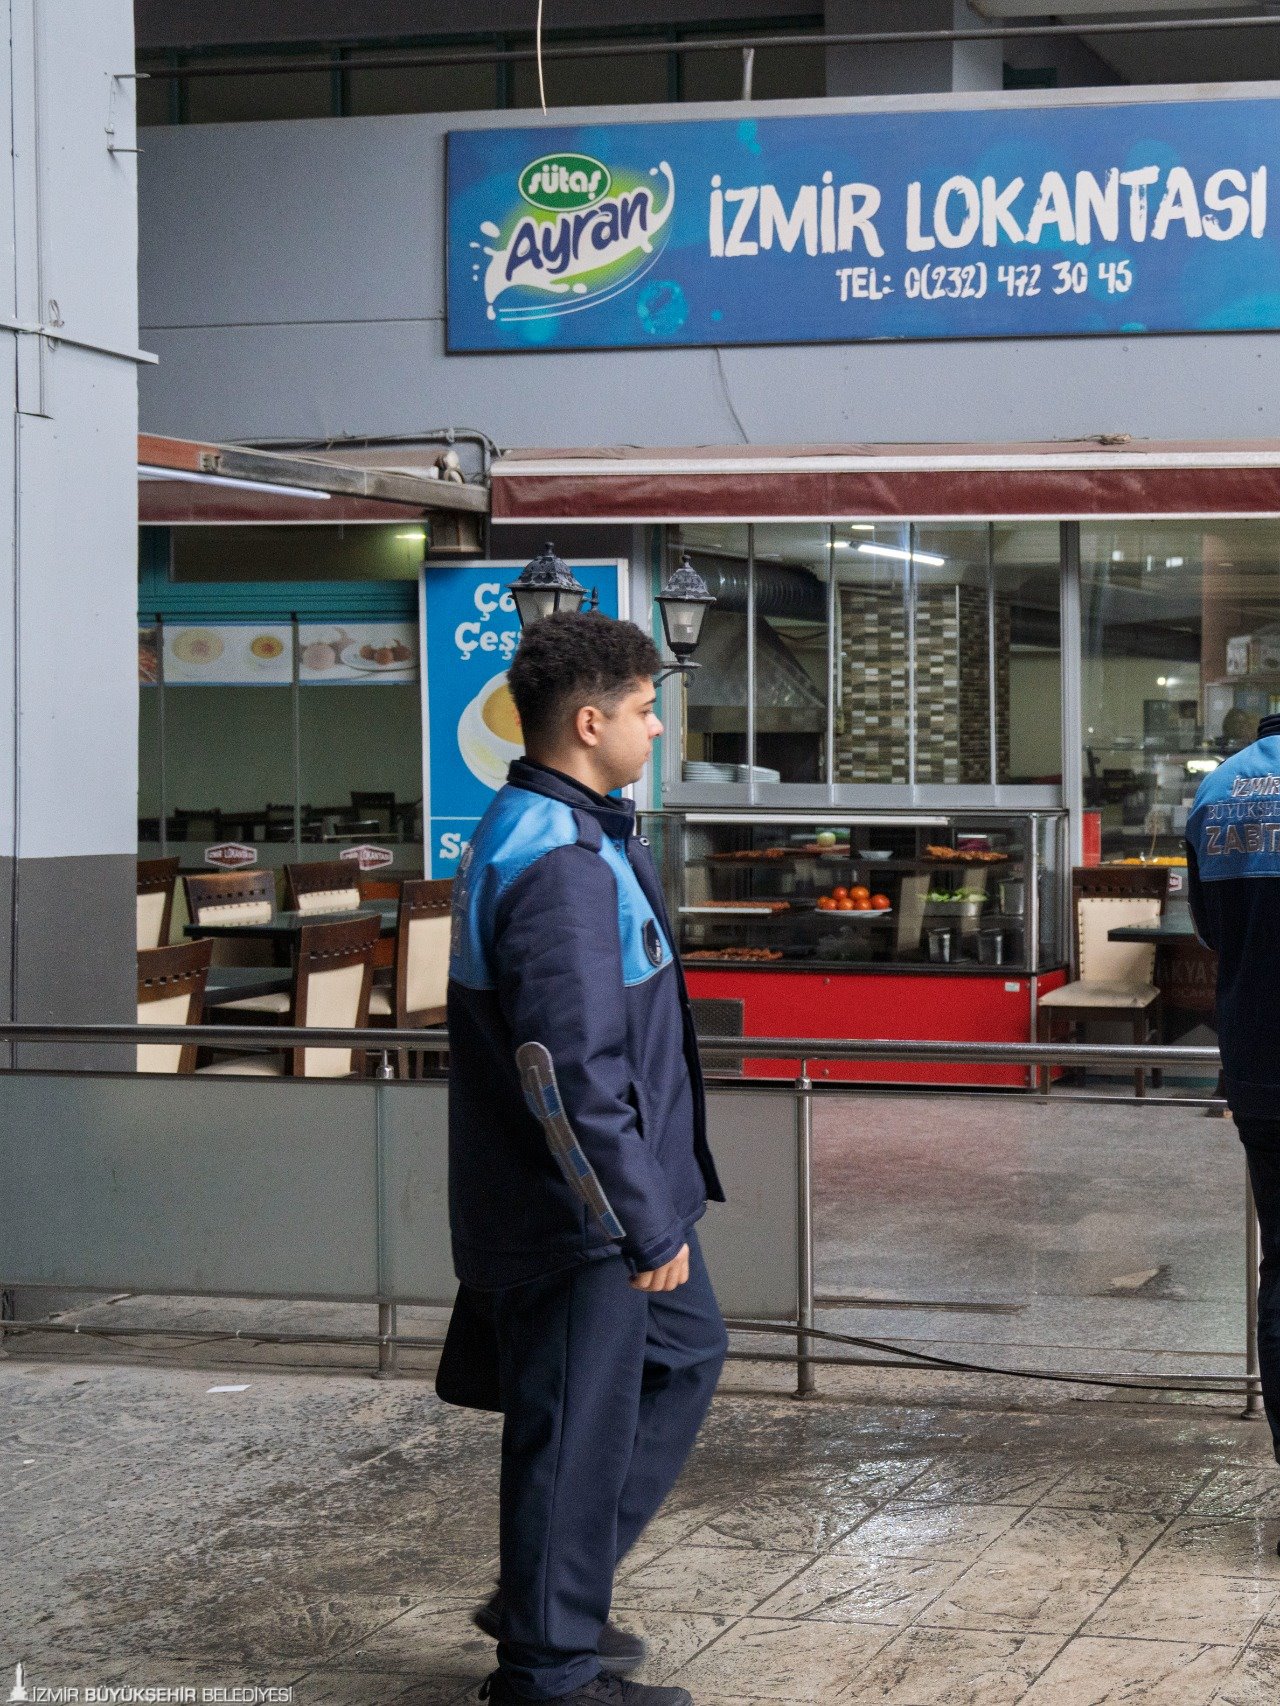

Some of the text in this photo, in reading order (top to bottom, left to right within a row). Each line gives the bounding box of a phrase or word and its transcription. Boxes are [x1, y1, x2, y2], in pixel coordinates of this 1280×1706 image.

[527, 163, 601, 200] sütaş
[709, 165, 1267, 258] İZMİR LOKANTASI
[505, 193, 649, 280] Ayran
[836, 260, 1133, 302] TEL: 0(232) 472 30 45
